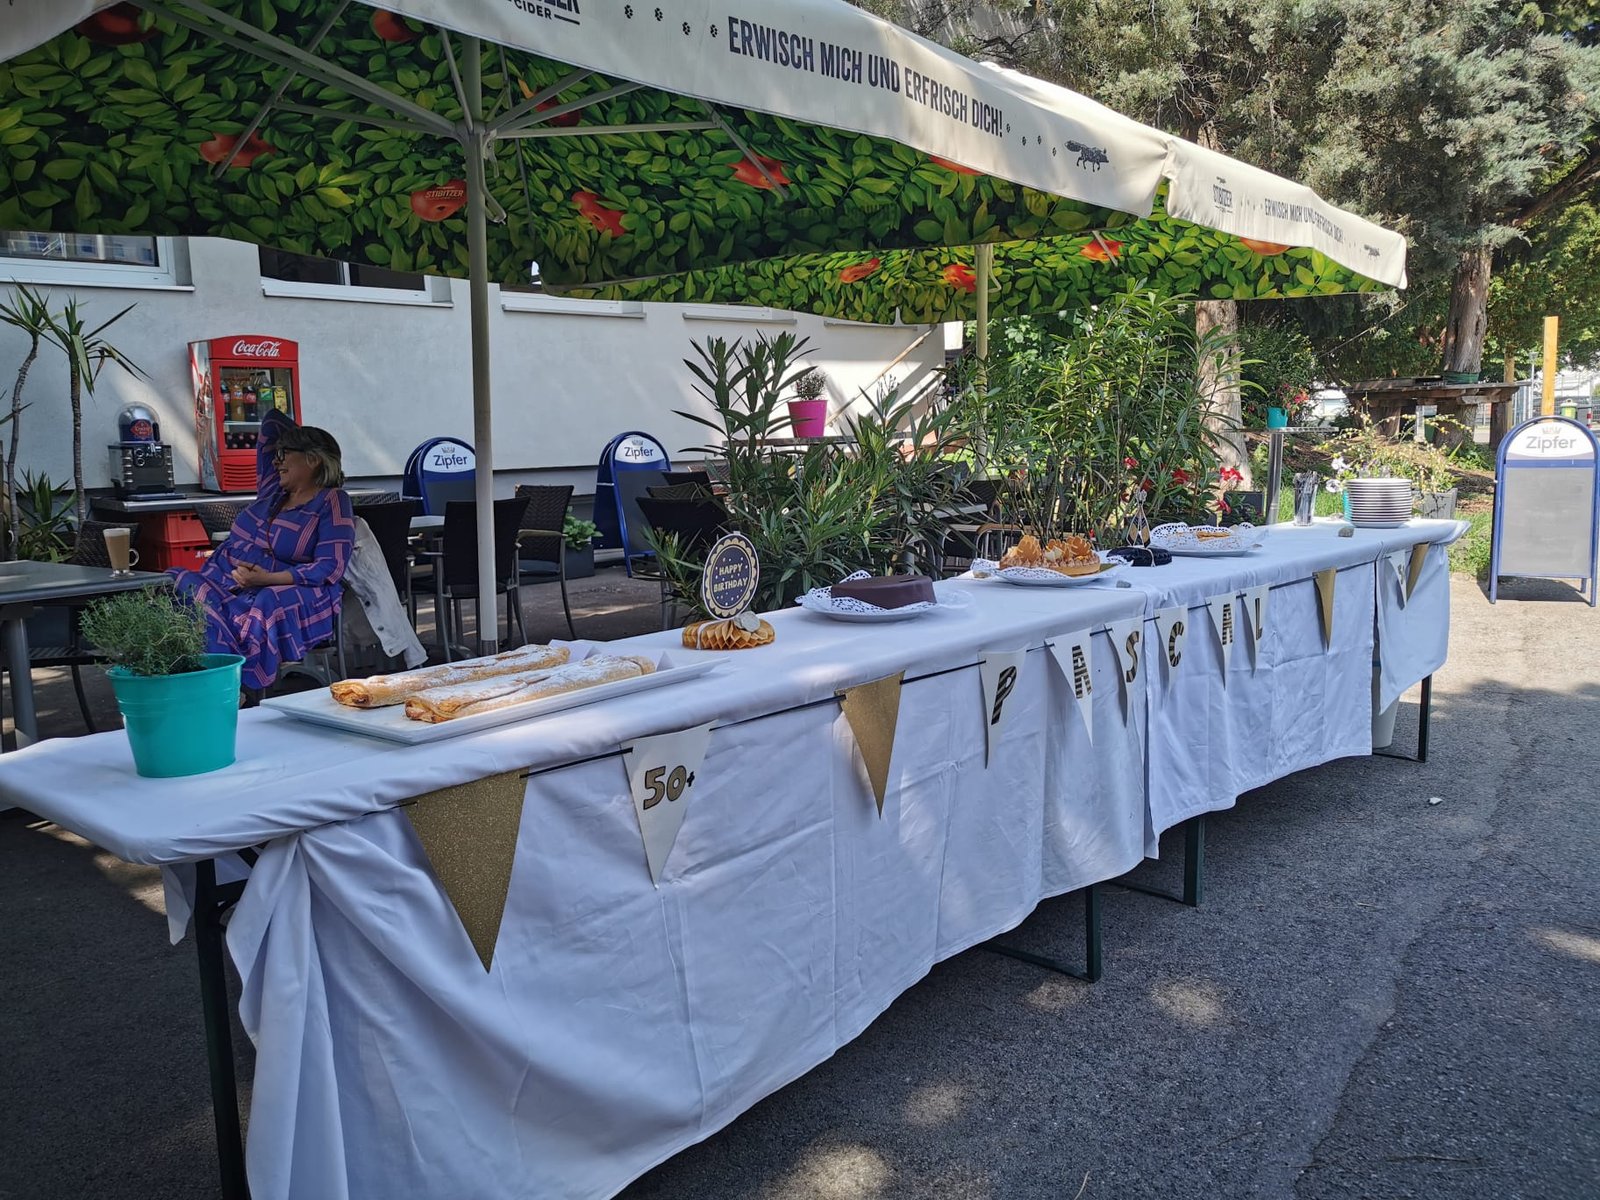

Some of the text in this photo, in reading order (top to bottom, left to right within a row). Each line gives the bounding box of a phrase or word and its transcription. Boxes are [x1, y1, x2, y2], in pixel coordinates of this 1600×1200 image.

[514, 0, 552, 20] CIDER
[728, 16, 1003, 138] ERWISCH MICH UND ERFRISCH DICH!
[425, 190, 464, 198] STIBITZER
[232, 340, 282, 357] Coca-Cola
[1526, 436, 1577, 453] Zipfer
[624, 446, 654, 460] Zipfer
[433, 454, 468, 469] Zipfer
[719, 563, 743, 576] HAPPY
[713, 577, 748, 593] BIRTHDAY
